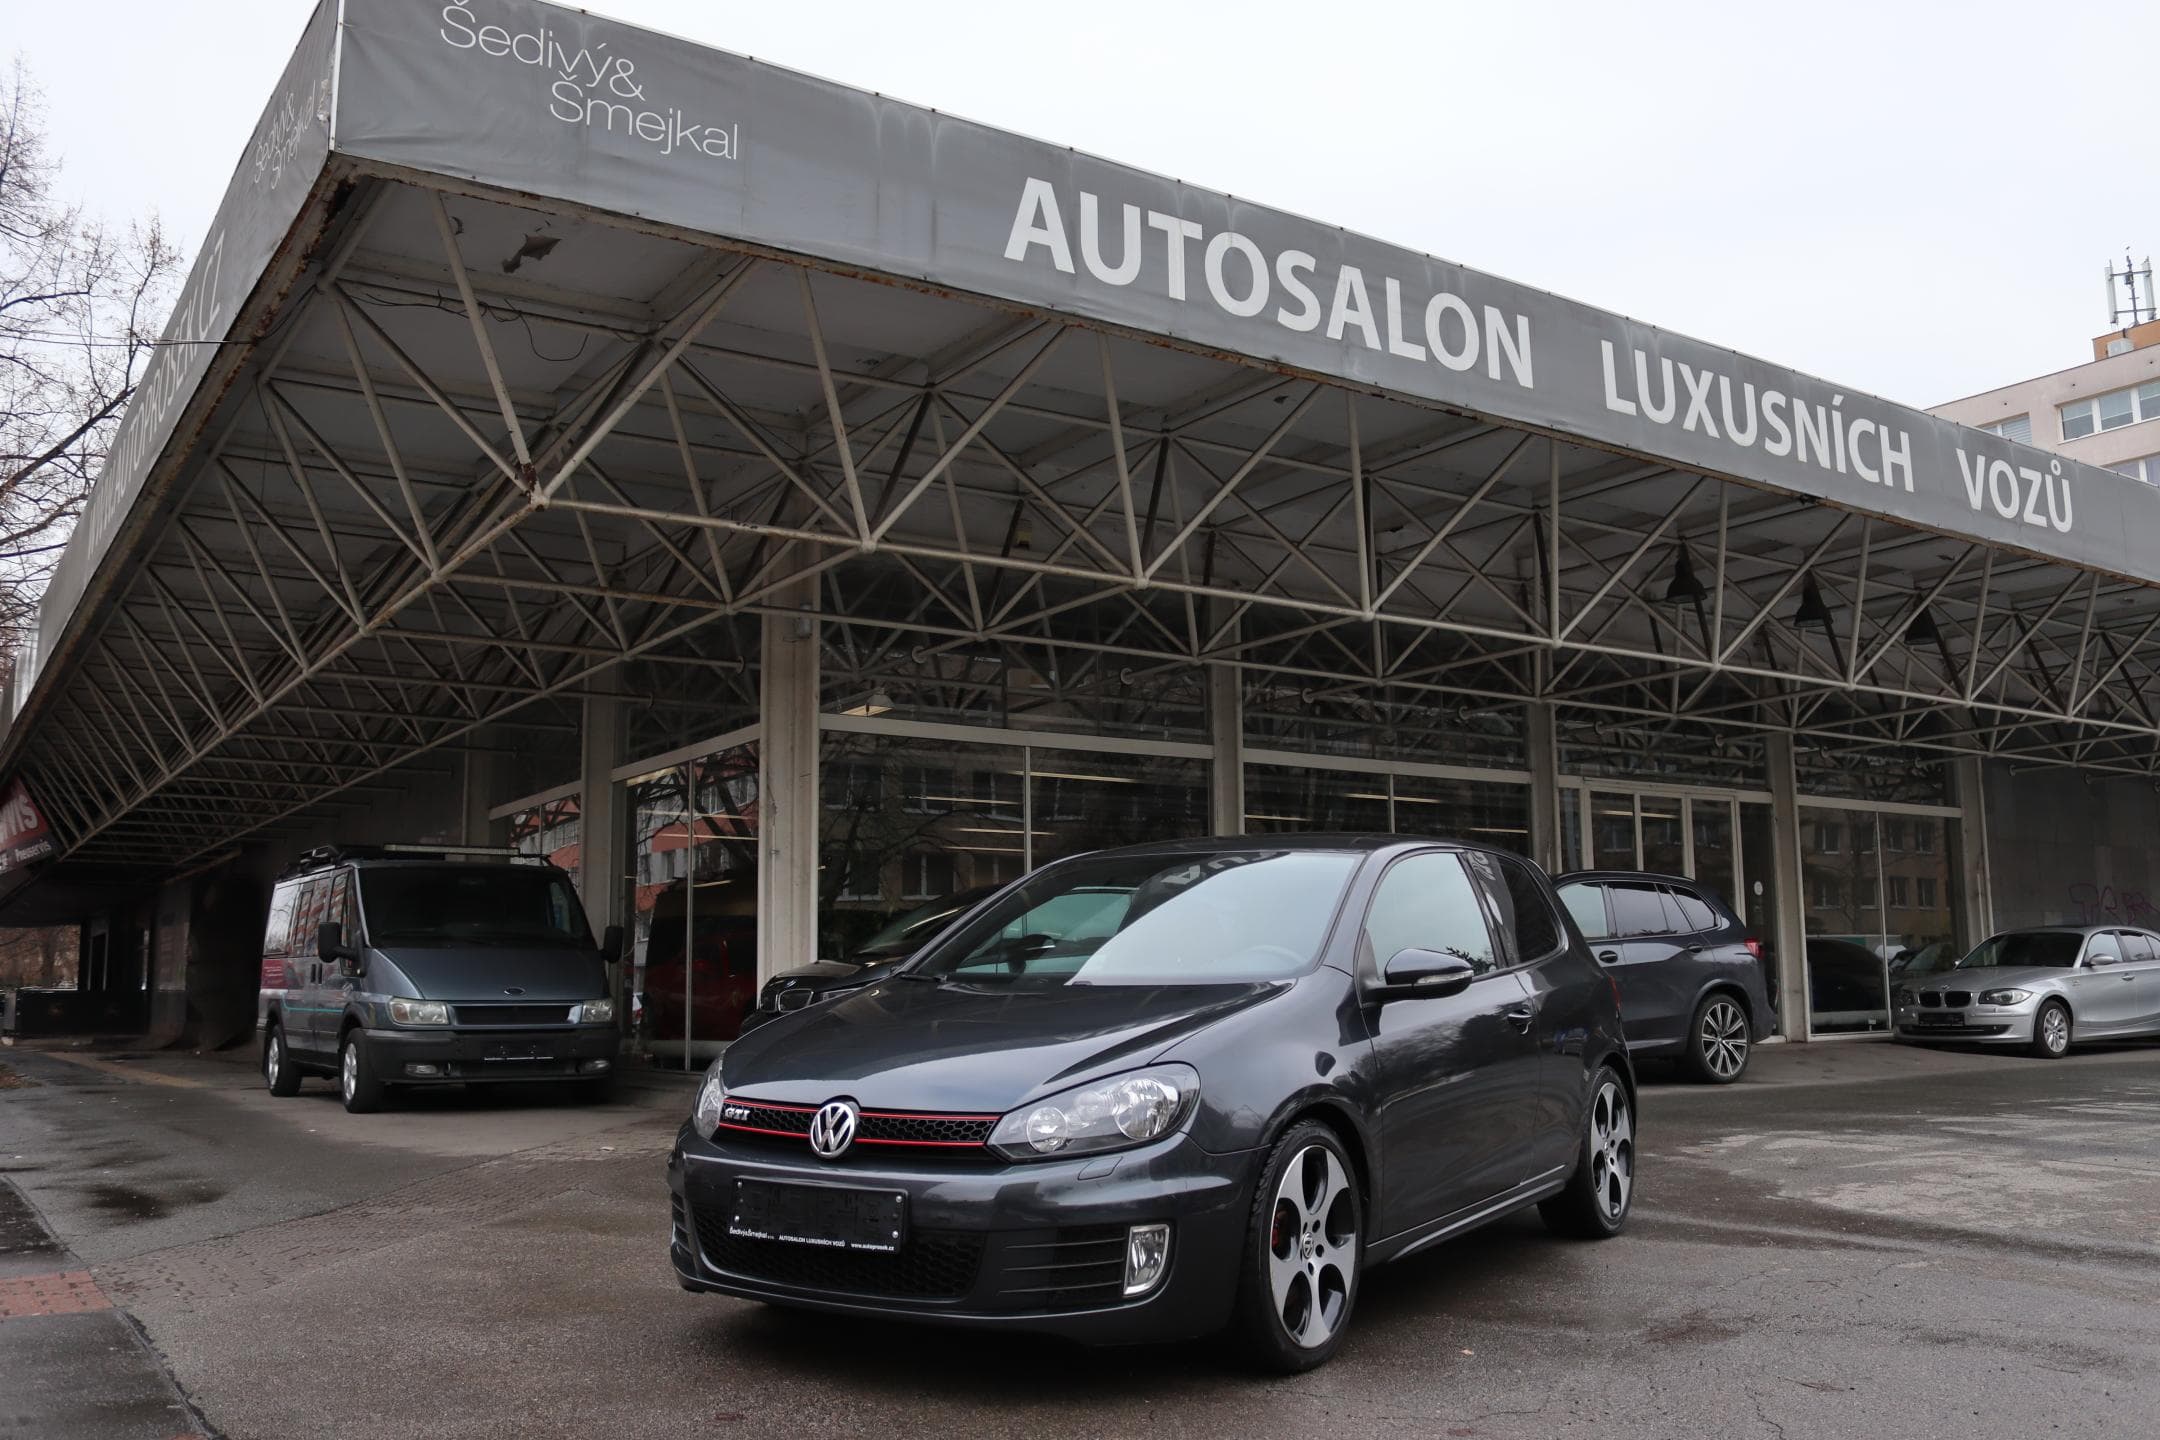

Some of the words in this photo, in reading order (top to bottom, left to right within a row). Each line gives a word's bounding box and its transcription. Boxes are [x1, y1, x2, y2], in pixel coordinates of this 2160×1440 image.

[440, 0, 645, 101] Šedivý&
[550, 70, 738, 160] Šmejkal
[1003, 176, 1534, 389] AUTOSALON
[1601, 340, 1915, 493] LUXUSNÍCH
[1956, 449, 2074, 533] VOZŮ
[725, 1107, 750, 1120] GTI
[779, 1234, 805, 1243] AUTOSALON
